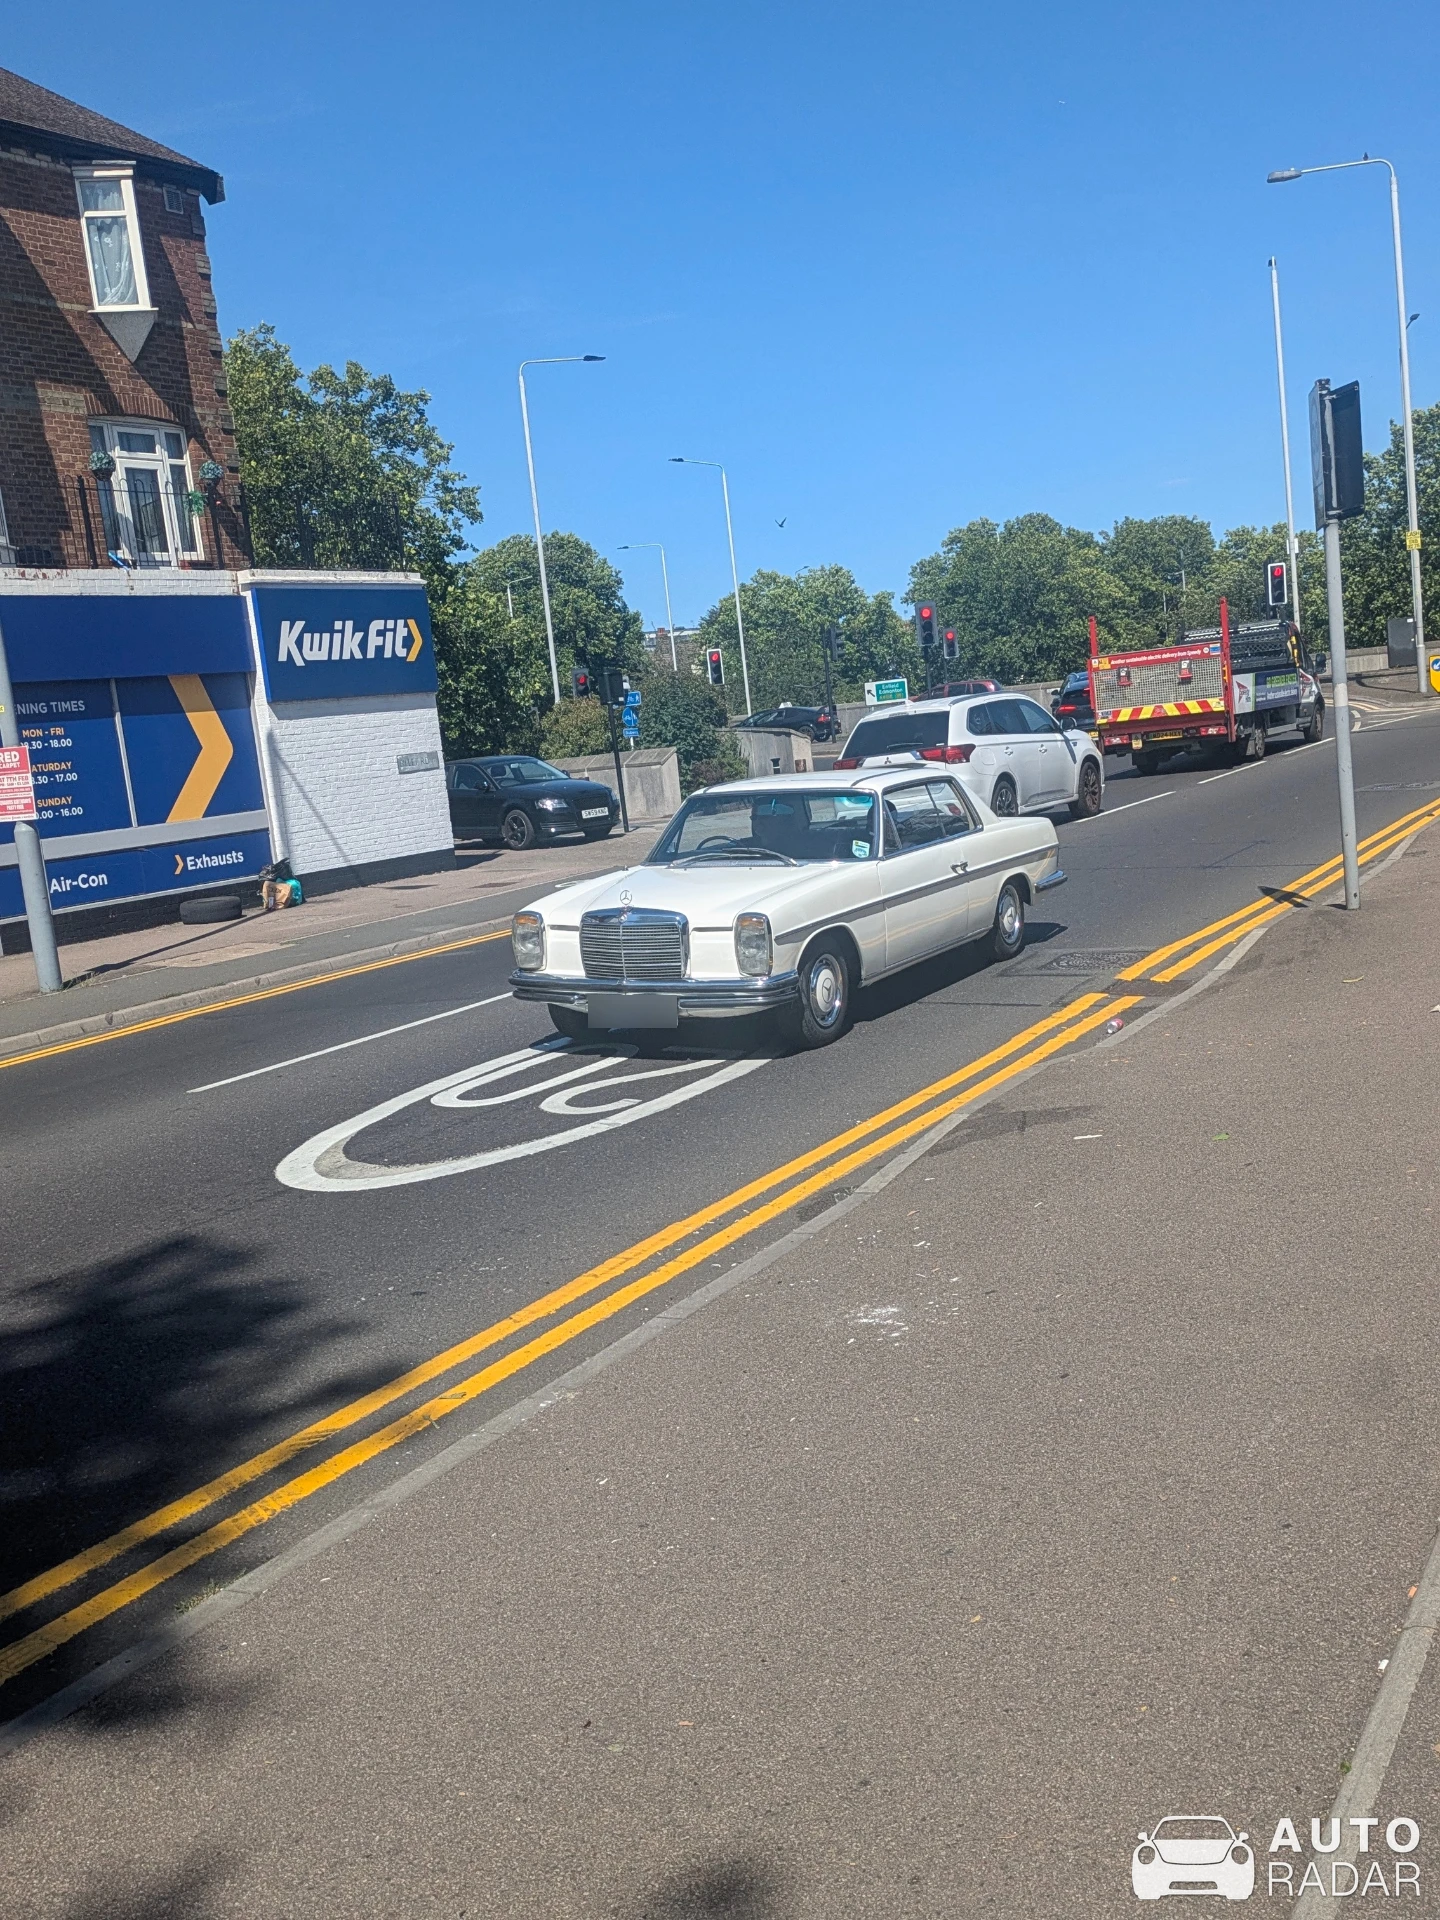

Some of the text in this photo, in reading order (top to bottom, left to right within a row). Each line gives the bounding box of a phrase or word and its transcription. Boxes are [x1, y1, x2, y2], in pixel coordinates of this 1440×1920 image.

[14, 702, 48, 715] NING
[50, 700, 85, 712] TIMES
[22, 728, 43, 738] MON
[50, 727, 64, 736] FRI
[50, 738, 72, 748] 18.00
[31, 761, 72, 772] ATURDAY
[31, 775, 48, 785] 8.30
[55, 773, 77, 782] 17.00
[37, 796, 72, 808] SUNDAY
[60, 807, 83, 817] 16.00
[186, 850, 244, 871] Exhausts
[50, 872, 108, 894] Air-Con
